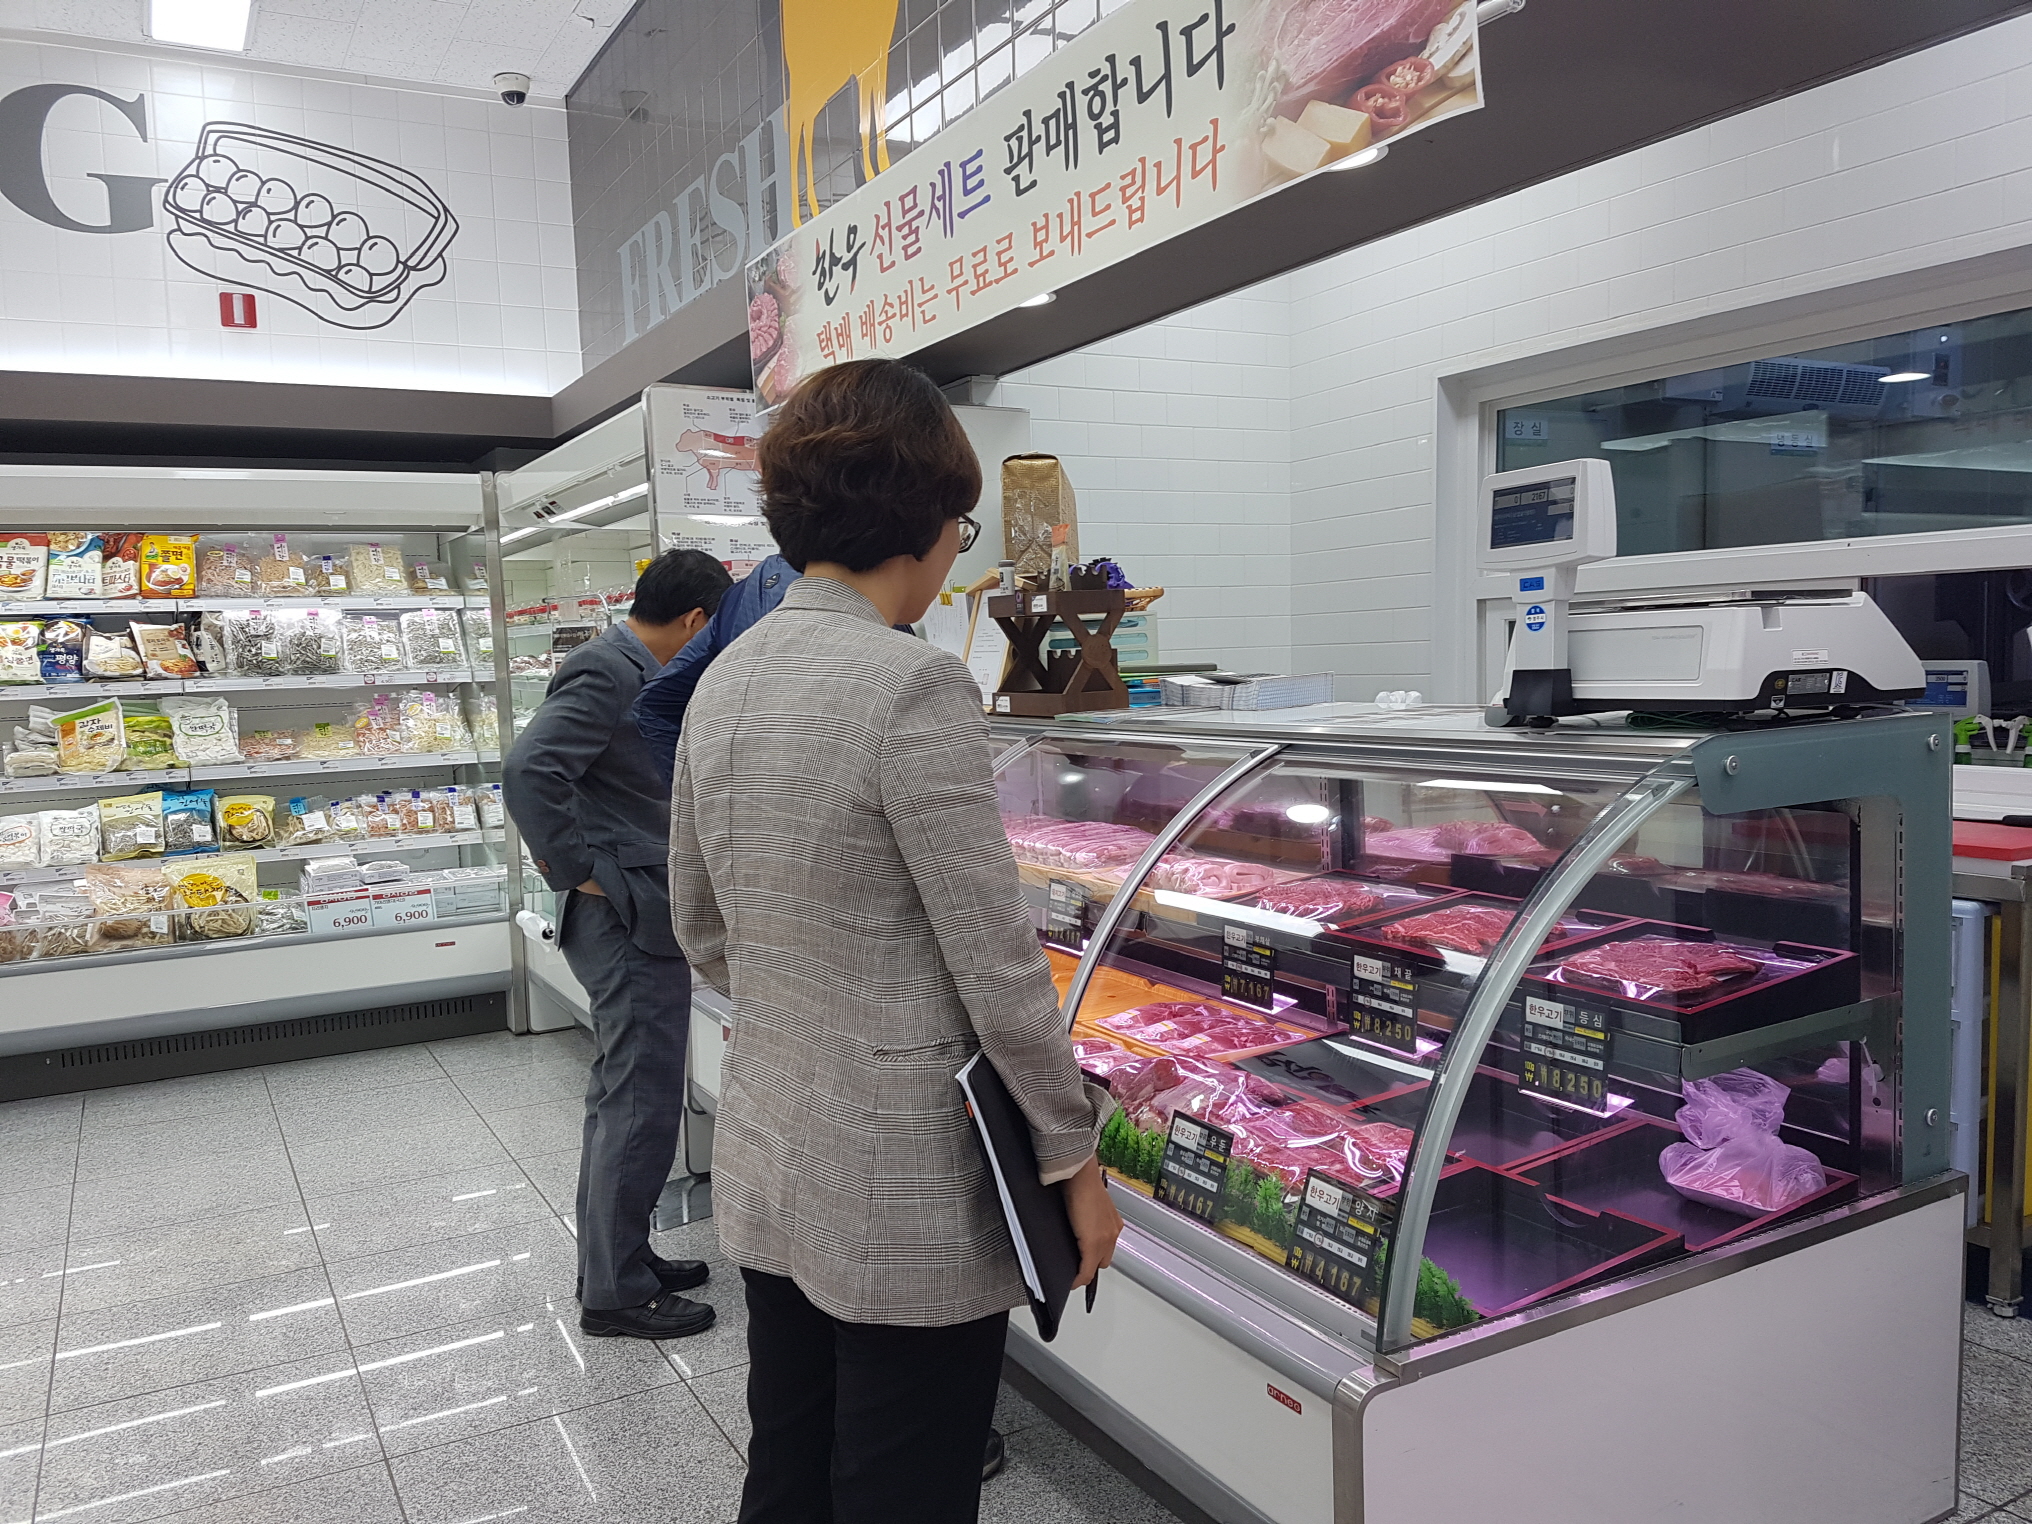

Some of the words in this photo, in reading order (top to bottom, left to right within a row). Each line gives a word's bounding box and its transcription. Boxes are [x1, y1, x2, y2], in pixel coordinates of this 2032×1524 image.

[812, 223, 867, 306] 한우
[870, 148, 991, 274] 선물세트
[1003, 0, 1236, 197] 판매합니다
[617, 106, 794, 346] FRESH
[816, 312, 853, 364] 택배
[859, 276, 939, 350] 배송비는
[946, 232, 1018, 312] 무료로
[1031, 118, 1226, 266] 보내드립니다
[160, 549, 183, 562] 쫄면
[1523, 580, 1541, 589] CAS
[55, 653, 79, 665] 평양
[79, 718, 102, 729] 감자
[333, 915, 368, 928] 6,900
[394, 909, 429, 924] 6,900
[1356, 961, 1381, 977] 한우고기
[1529, 1003, 1562, 1023] 한우고기
[1579, 1011, 1602, 1028] 등심
[1174, 1124, 1198, 1145] 한우고기
[1310, 1185, 1340, 1211] 한우고기
